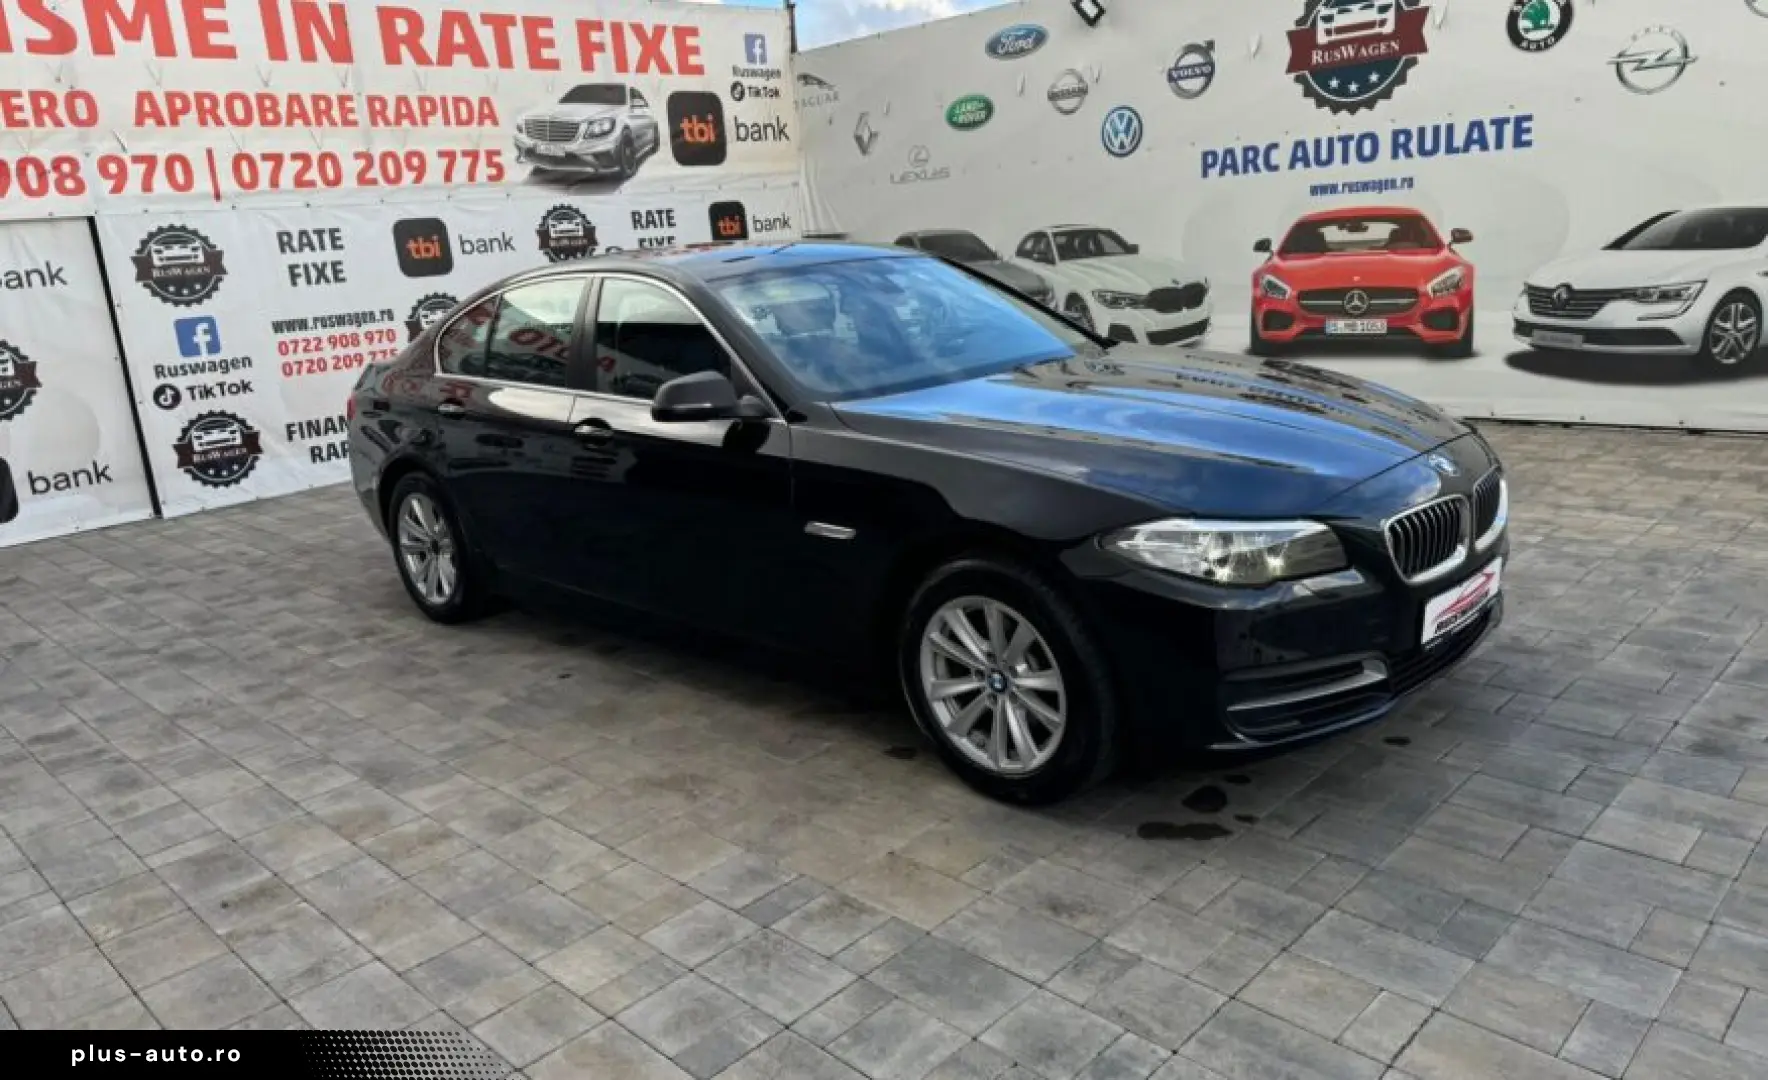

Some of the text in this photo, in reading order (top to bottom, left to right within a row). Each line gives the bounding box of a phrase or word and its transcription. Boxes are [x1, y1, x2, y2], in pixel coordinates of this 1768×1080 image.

[260, 0, 354, 63] IN
[376, 6, 561, 69] RATE
[575, 19, 705, 75] FIXE
[996, 33, 1037, 55] Ford
[1171, 63, 1212, 81] VOLVO
[134, 90, 359, 128] APROBARE
[367, 94, 499, 127] RAPIDA
[681, 112, 790, 143] tbi bank
[1200, 113, 1534, 178] PARC AUTO RULATE
[98, 153, 195, 194] 970
[232, 152, 343, 190] 0720
[353, 151, 427, 187] 209
[437, 149, 505, 184] 775
[1309, 176, 1414, 197] www.ruswagen.ro
[630, 208, 677, 230] RATE
[752, 212, 792, 232] bank
[276, 228, 345, 254] RATE
[406, 231, 516, 259] tbi bank
[0, 260, 68, 290] ank
[288, 260, 347, 288] FIXE
[278, 328, 396, 356] 0722 908 970
[153, 356, 253, 379] Ruswagen
[282, 356, 328, 377] 0720
[331, 352, 364, 371] 209
[186, 379, 255, 401] TikTok
[27, 460, 113, 495] bank
